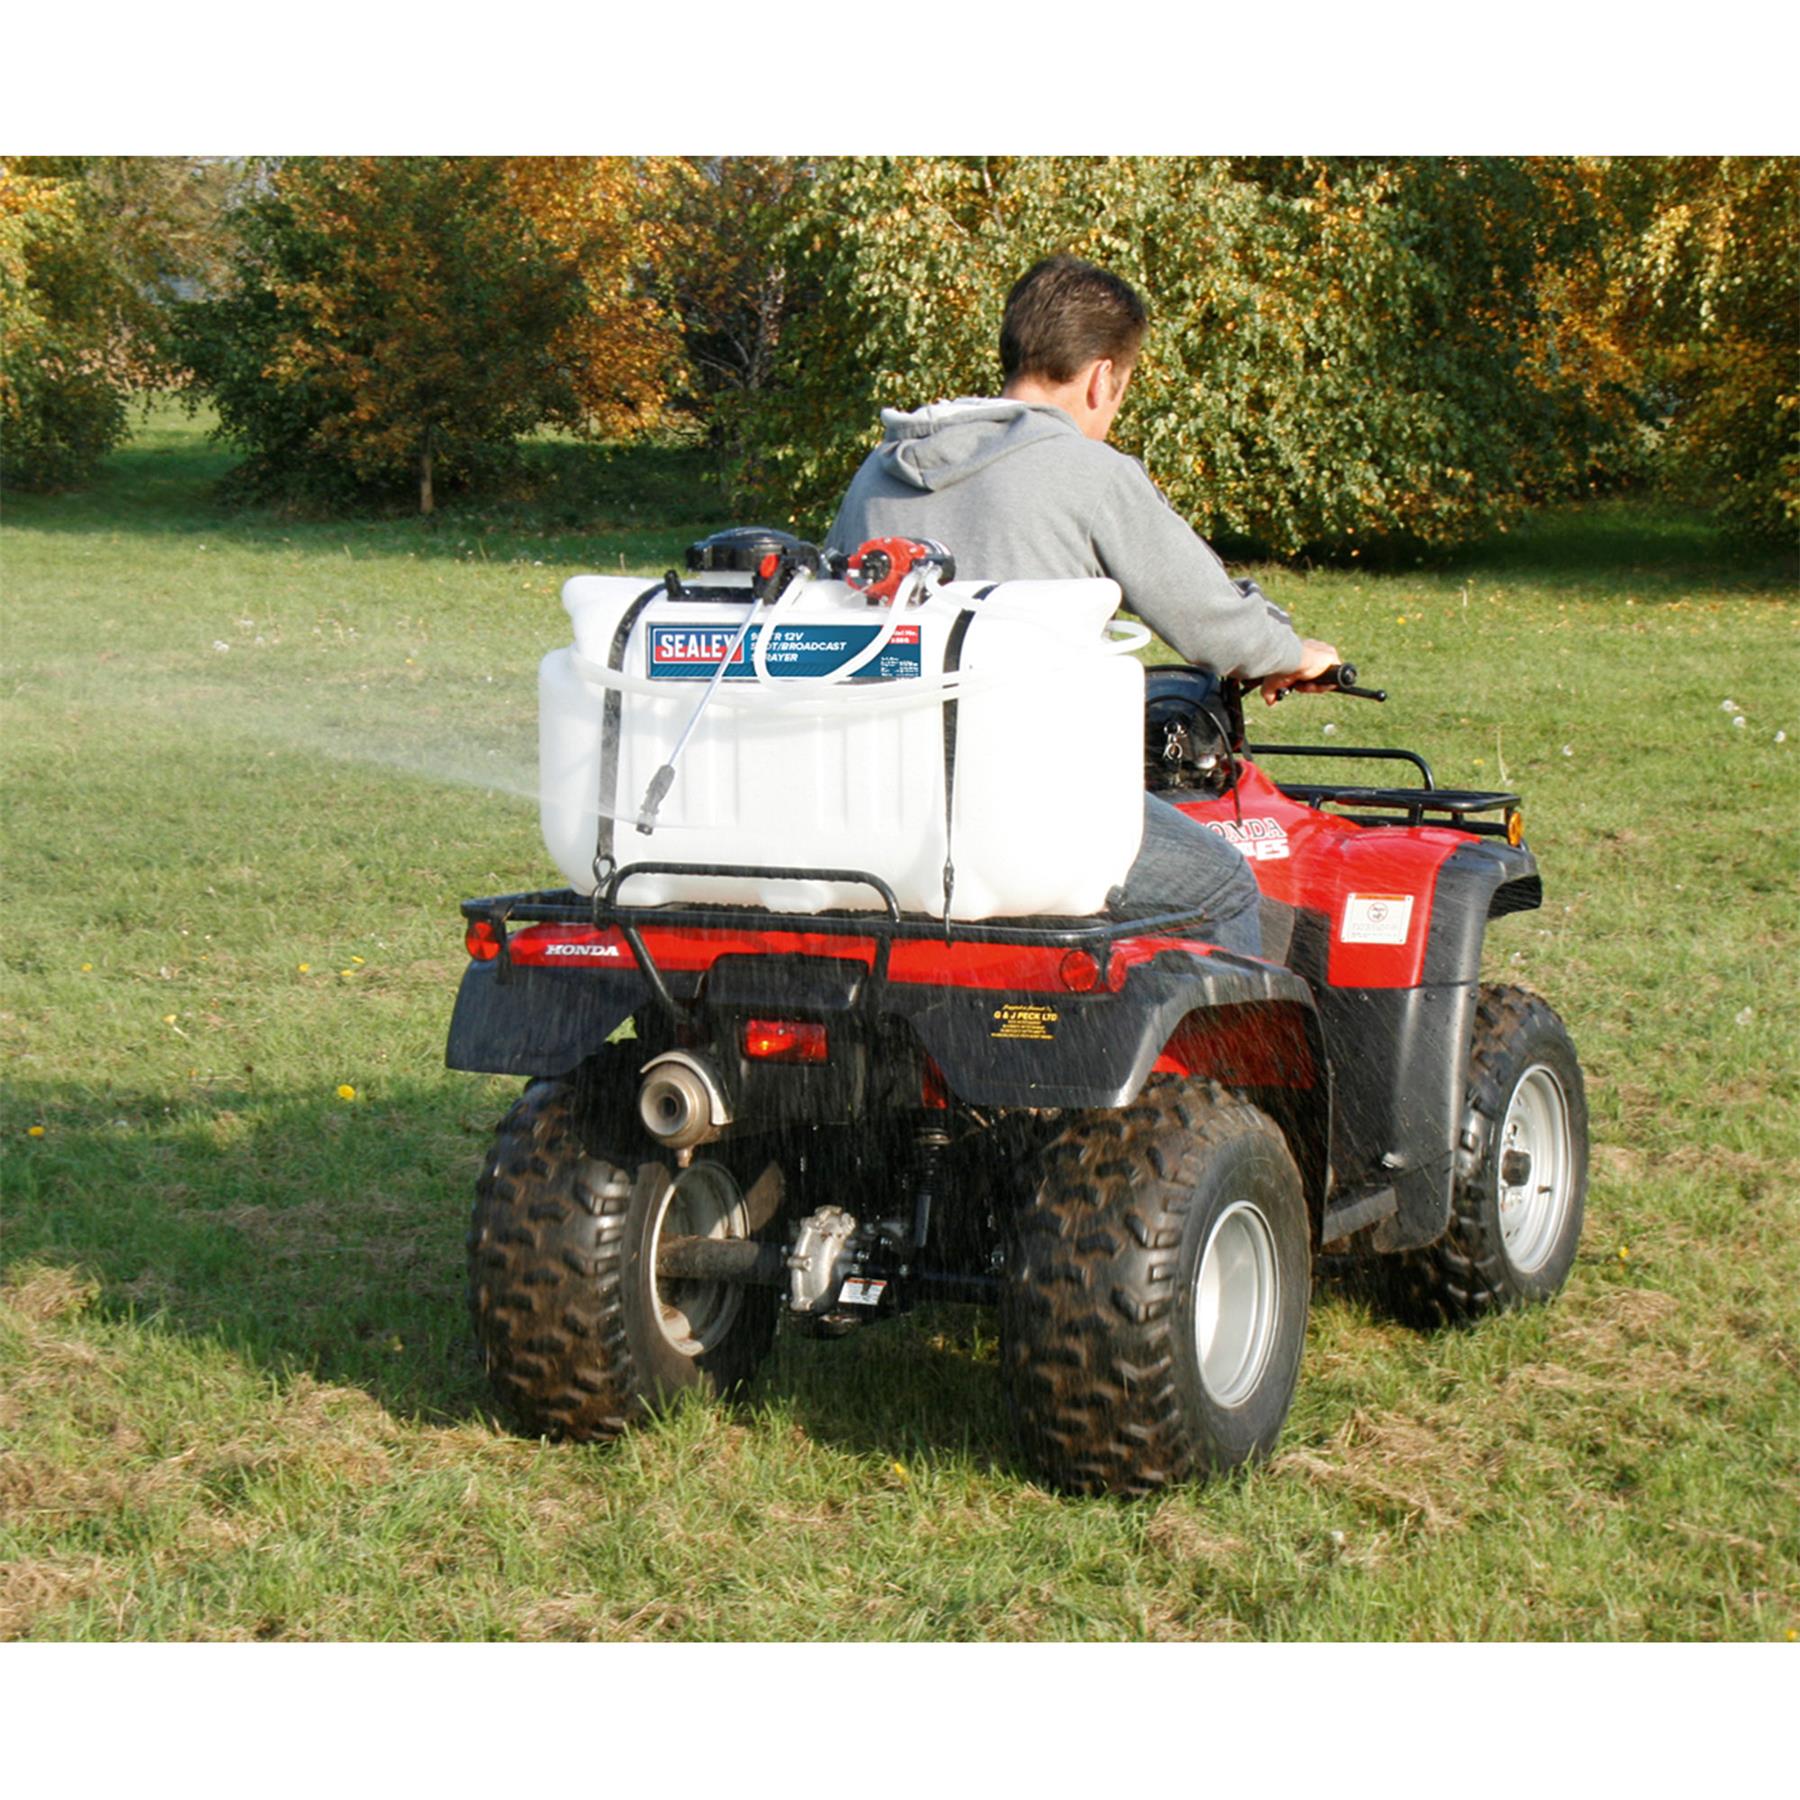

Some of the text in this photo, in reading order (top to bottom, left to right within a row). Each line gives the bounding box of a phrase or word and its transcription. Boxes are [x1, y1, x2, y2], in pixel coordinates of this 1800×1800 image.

[784, 632, 804, 641] 12V
[751, 641, 847, 651] SOT/BROADCAST
[1202, 817, 1288, 843] ONDA
[545, 944, 619, 957] HONDA
[1017, 1011, 1041, 1020] PECK
[1042, 1012, 1058, 1022] LTD
